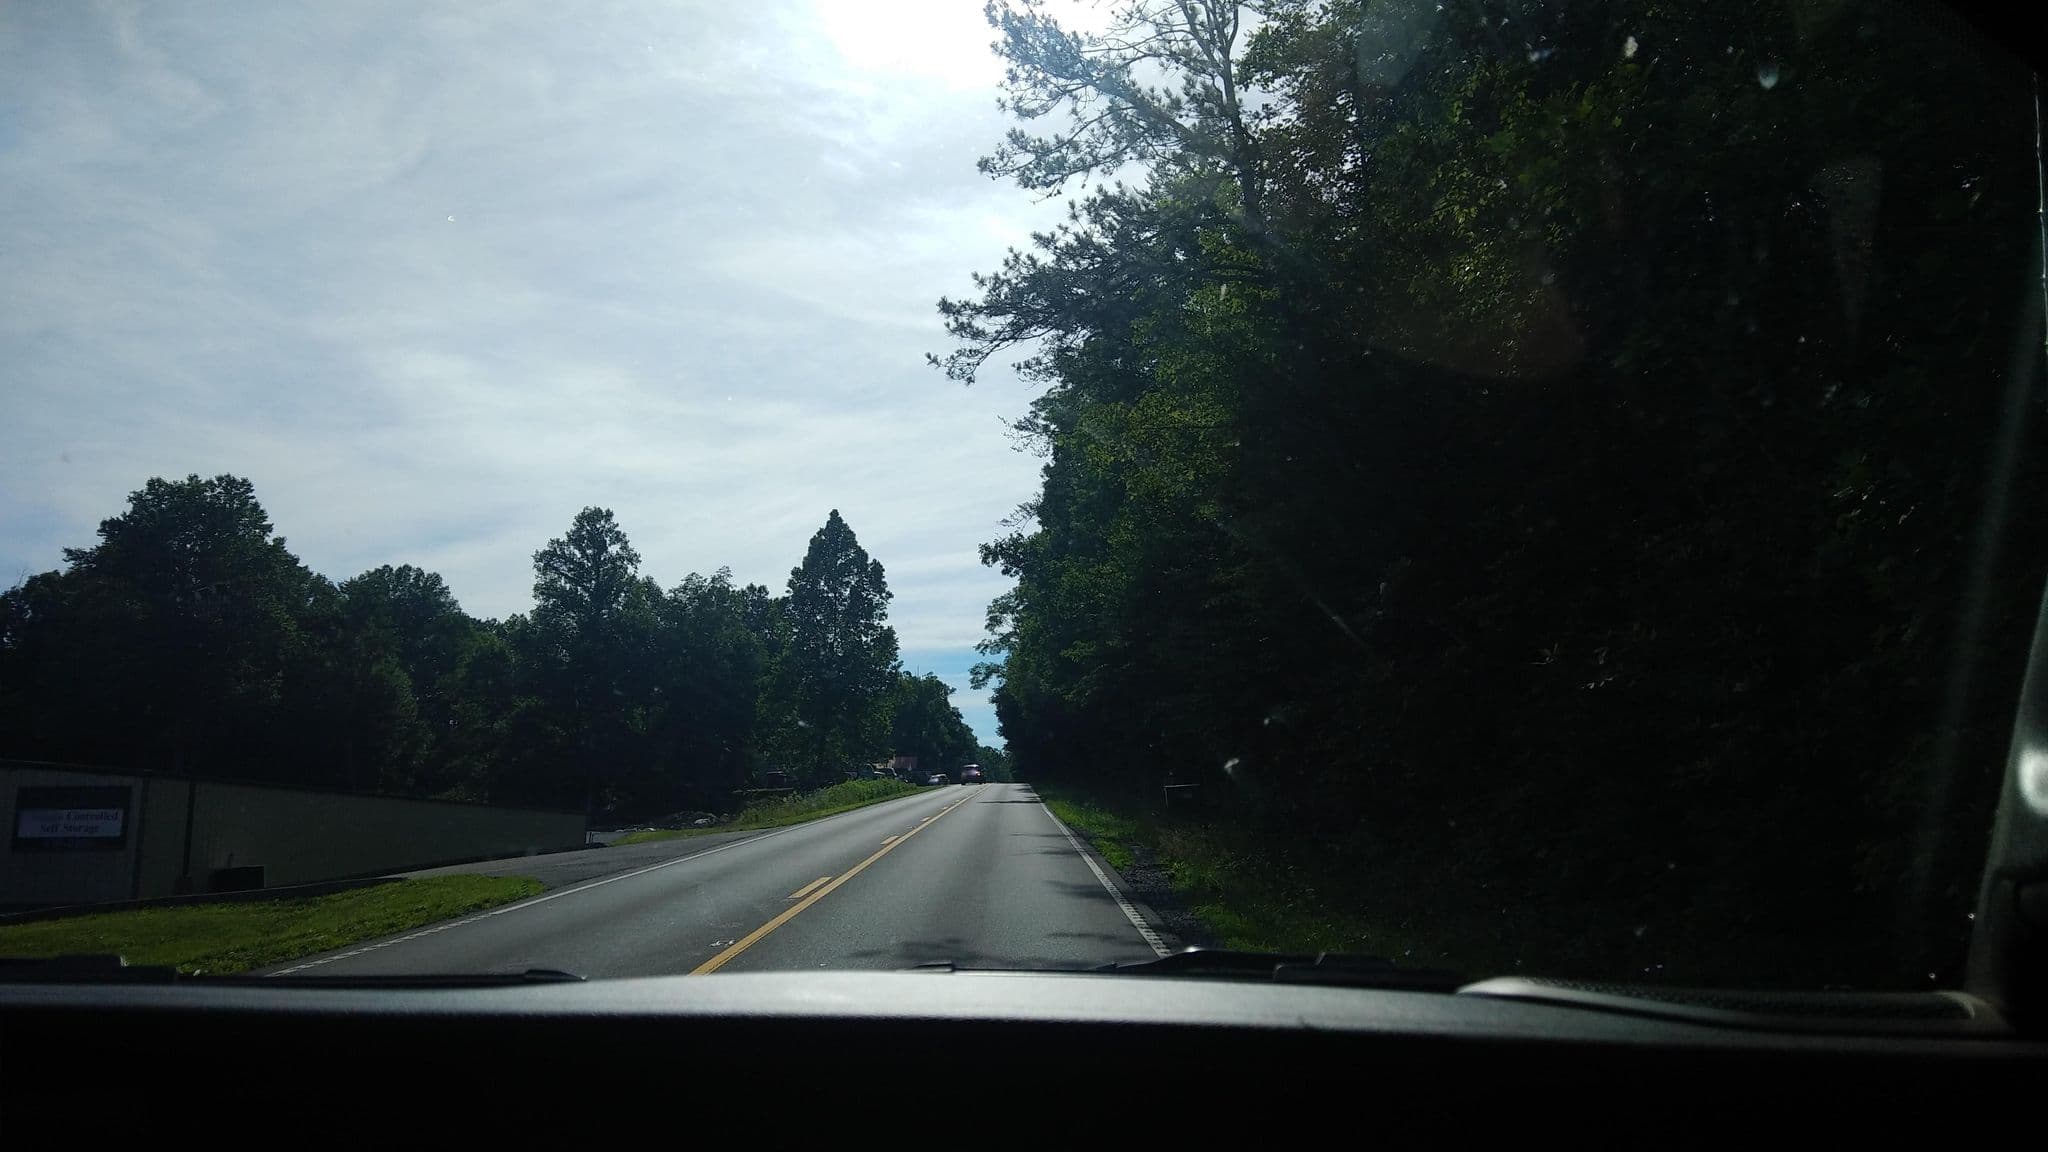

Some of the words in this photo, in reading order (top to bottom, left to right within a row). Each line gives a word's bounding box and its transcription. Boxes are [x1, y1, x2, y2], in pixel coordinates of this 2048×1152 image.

[67, 810, 118, 822] Controlled
[40, 823, 59, 833] Self
[63, 823, 100, 834] Storage
